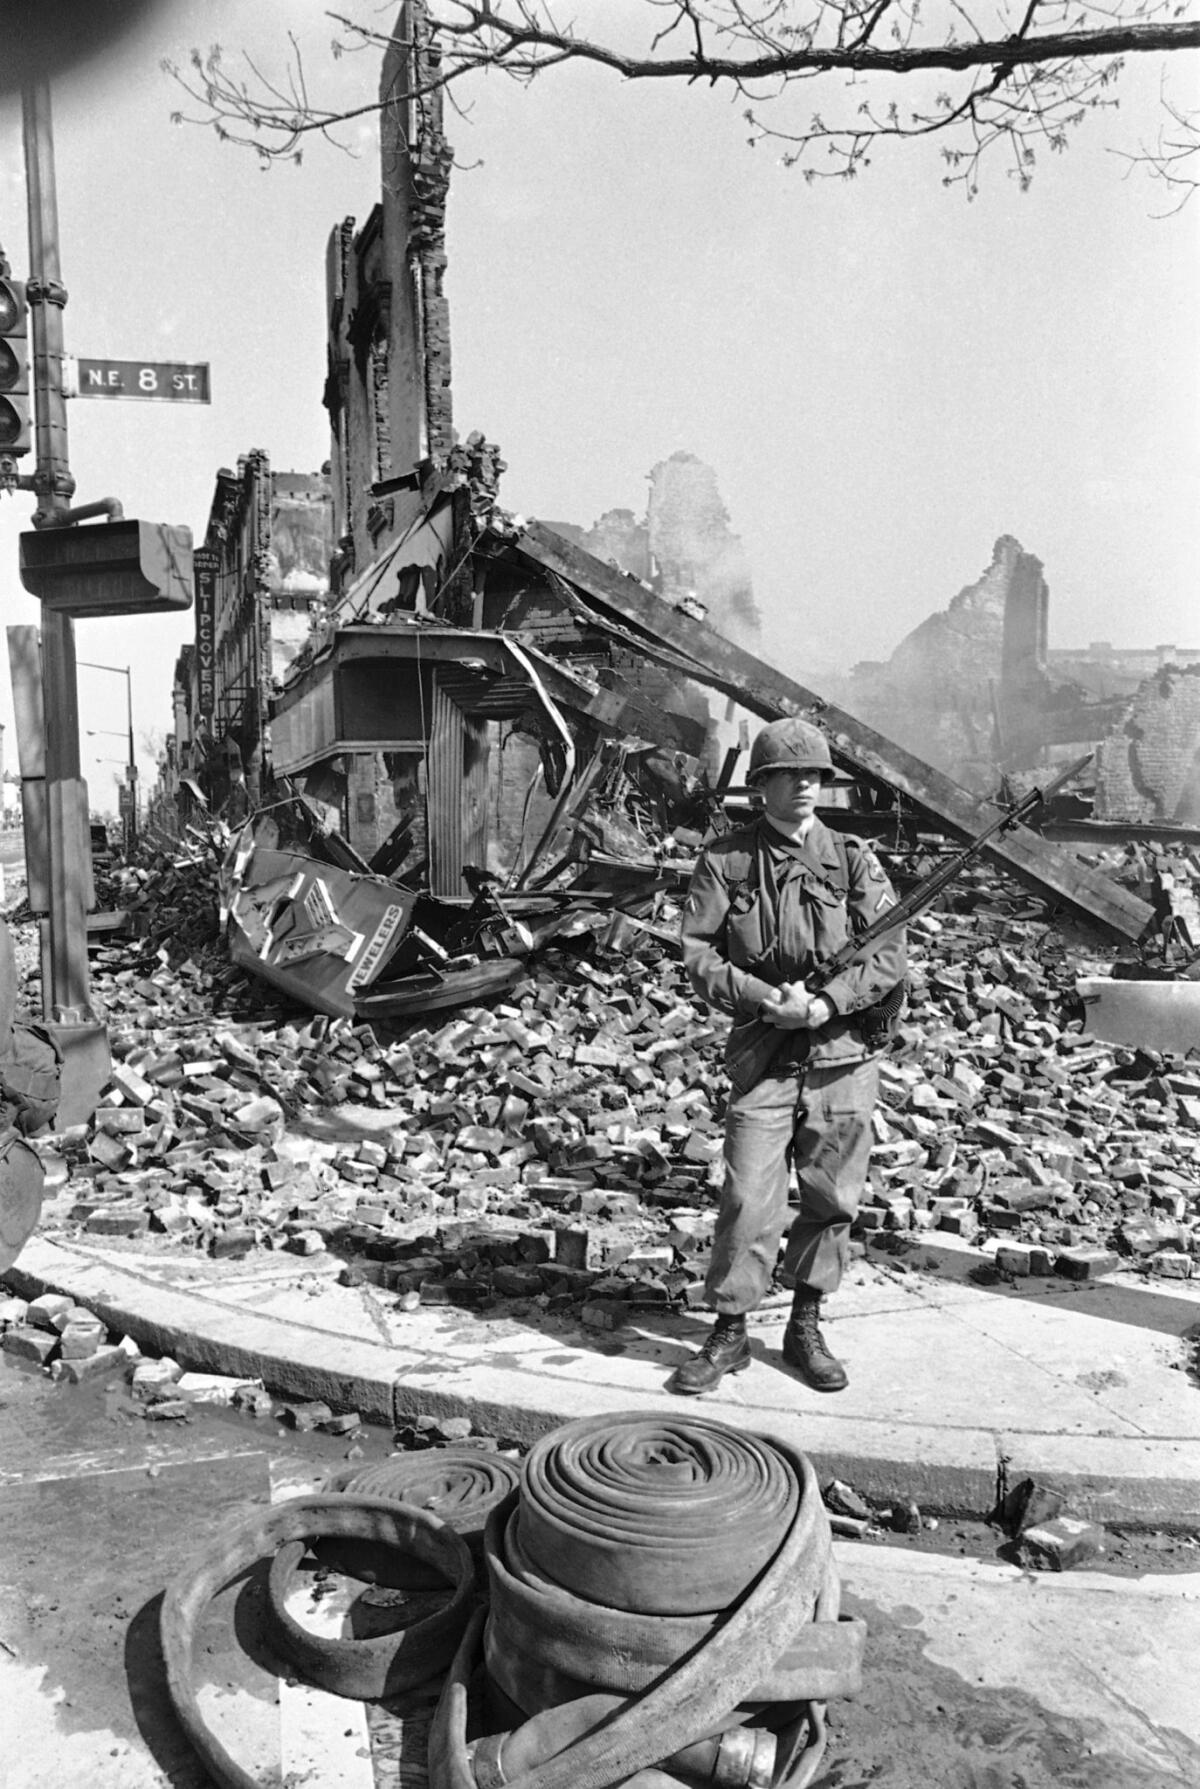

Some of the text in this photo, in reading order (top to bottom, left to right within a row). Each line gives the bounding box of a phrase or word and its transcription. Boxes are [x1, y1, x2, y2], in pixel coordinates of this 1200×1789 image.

[88, 368, 198, 391] N.E. 8 ST.
[199, 572, 213, 709] SLIPCOVERS
